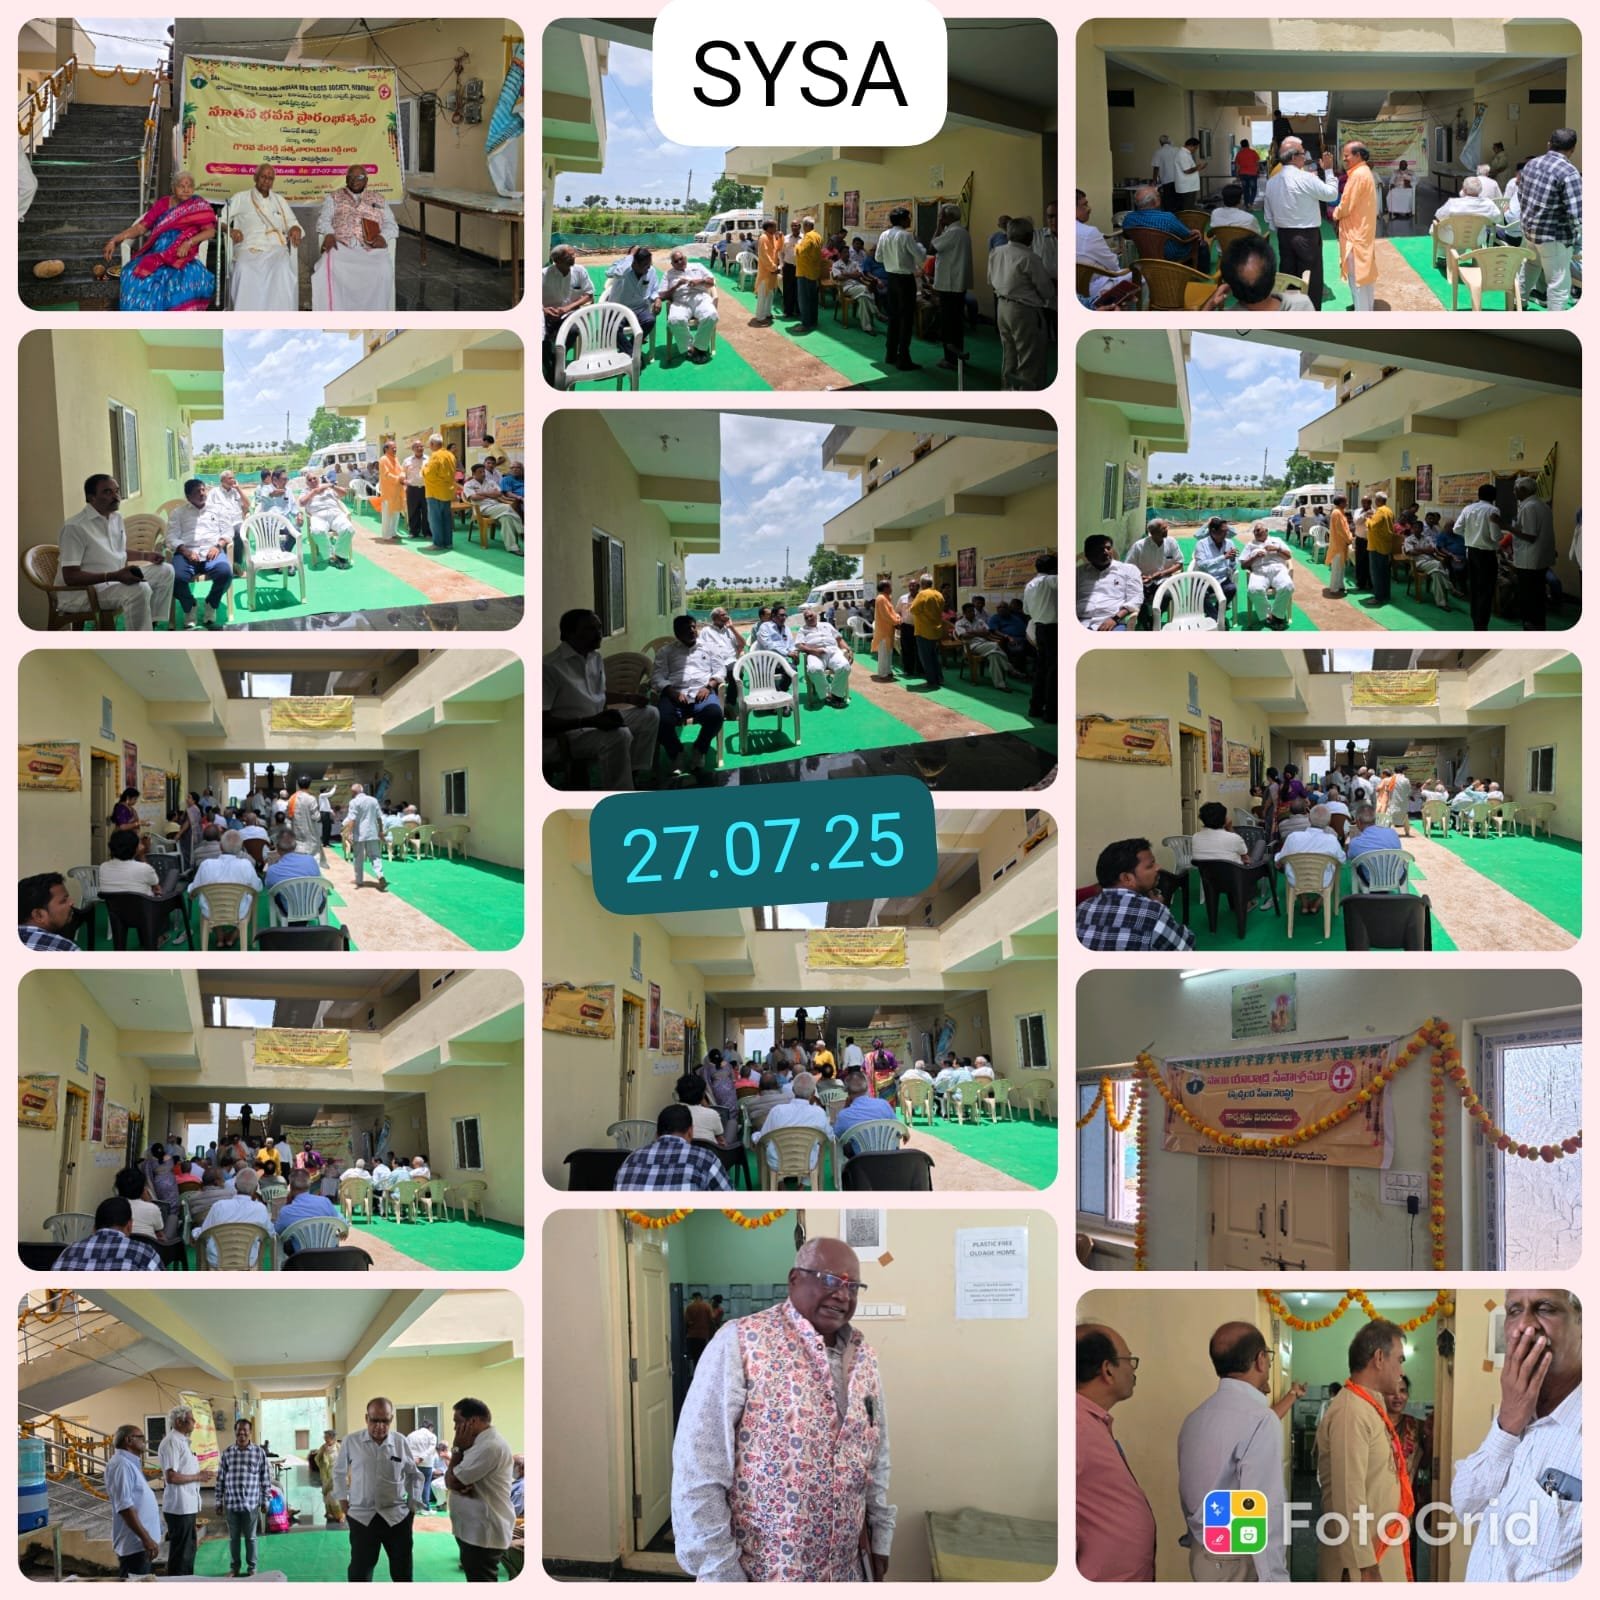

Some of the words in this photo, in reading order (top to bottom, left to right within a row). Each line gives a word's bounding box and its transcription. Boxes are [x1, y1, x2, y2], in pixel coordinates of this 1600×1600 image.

[208, 105, 257, 119] నూతన
[259, 109, 294, 121] భవన
[297, 111, 376, 126] ప్రారంభోత్సవం
